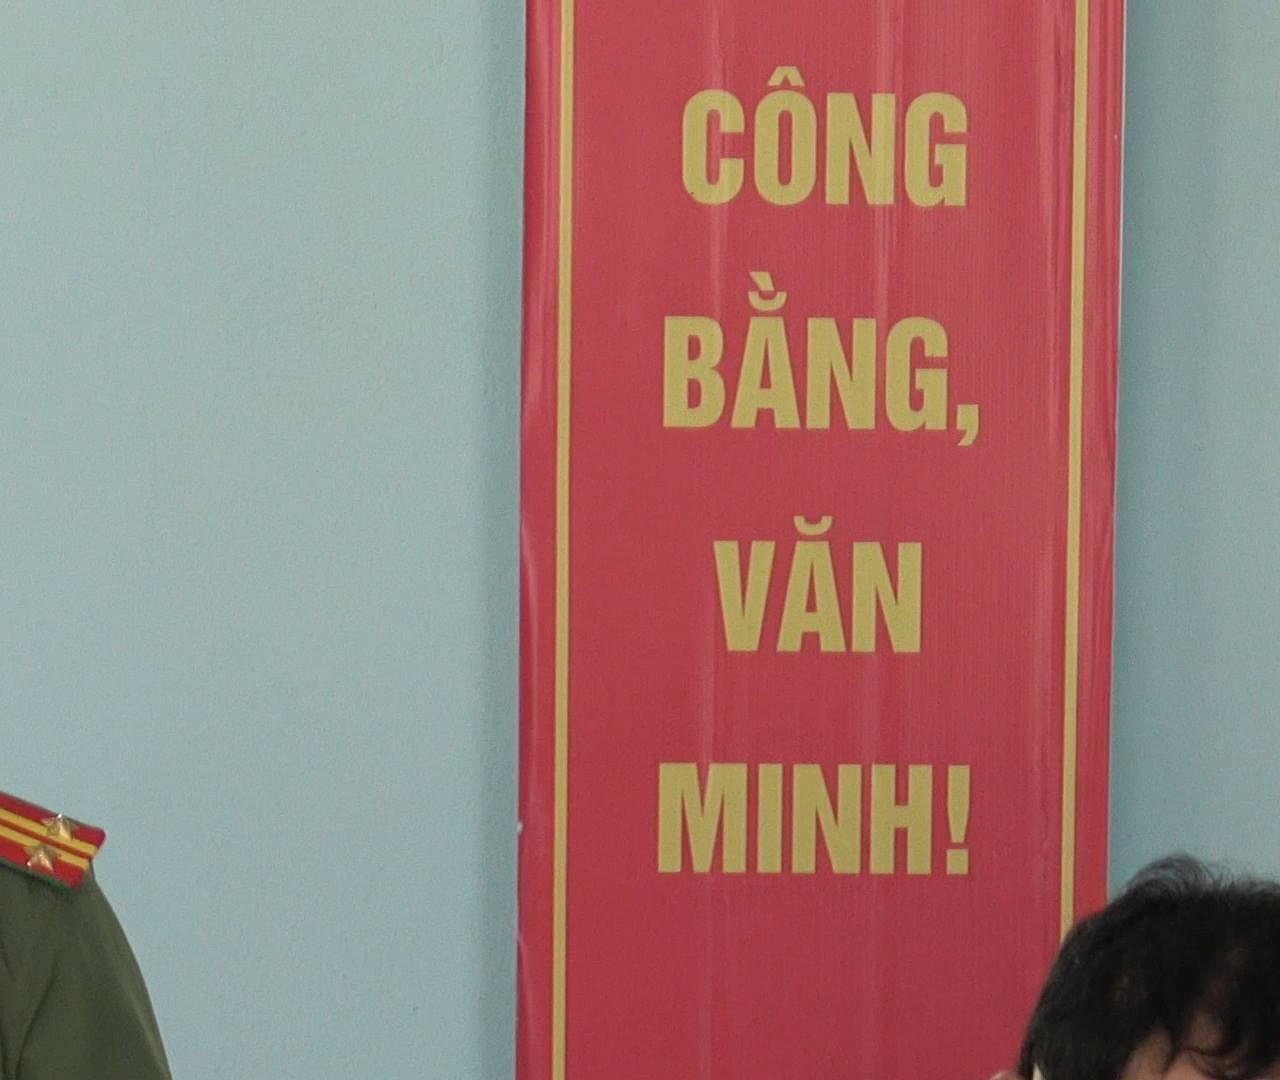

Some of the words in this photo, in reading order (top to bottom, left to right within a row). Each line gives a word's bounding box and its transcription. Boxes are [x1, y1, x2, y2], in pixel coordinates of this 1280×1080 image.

[681, 65, 968, 209] CÔNG
[662, 271, 980, 447] BẰNG,
[713, 515, 922, 653] VĂN
[657, 762, 970, 875] MINH!
